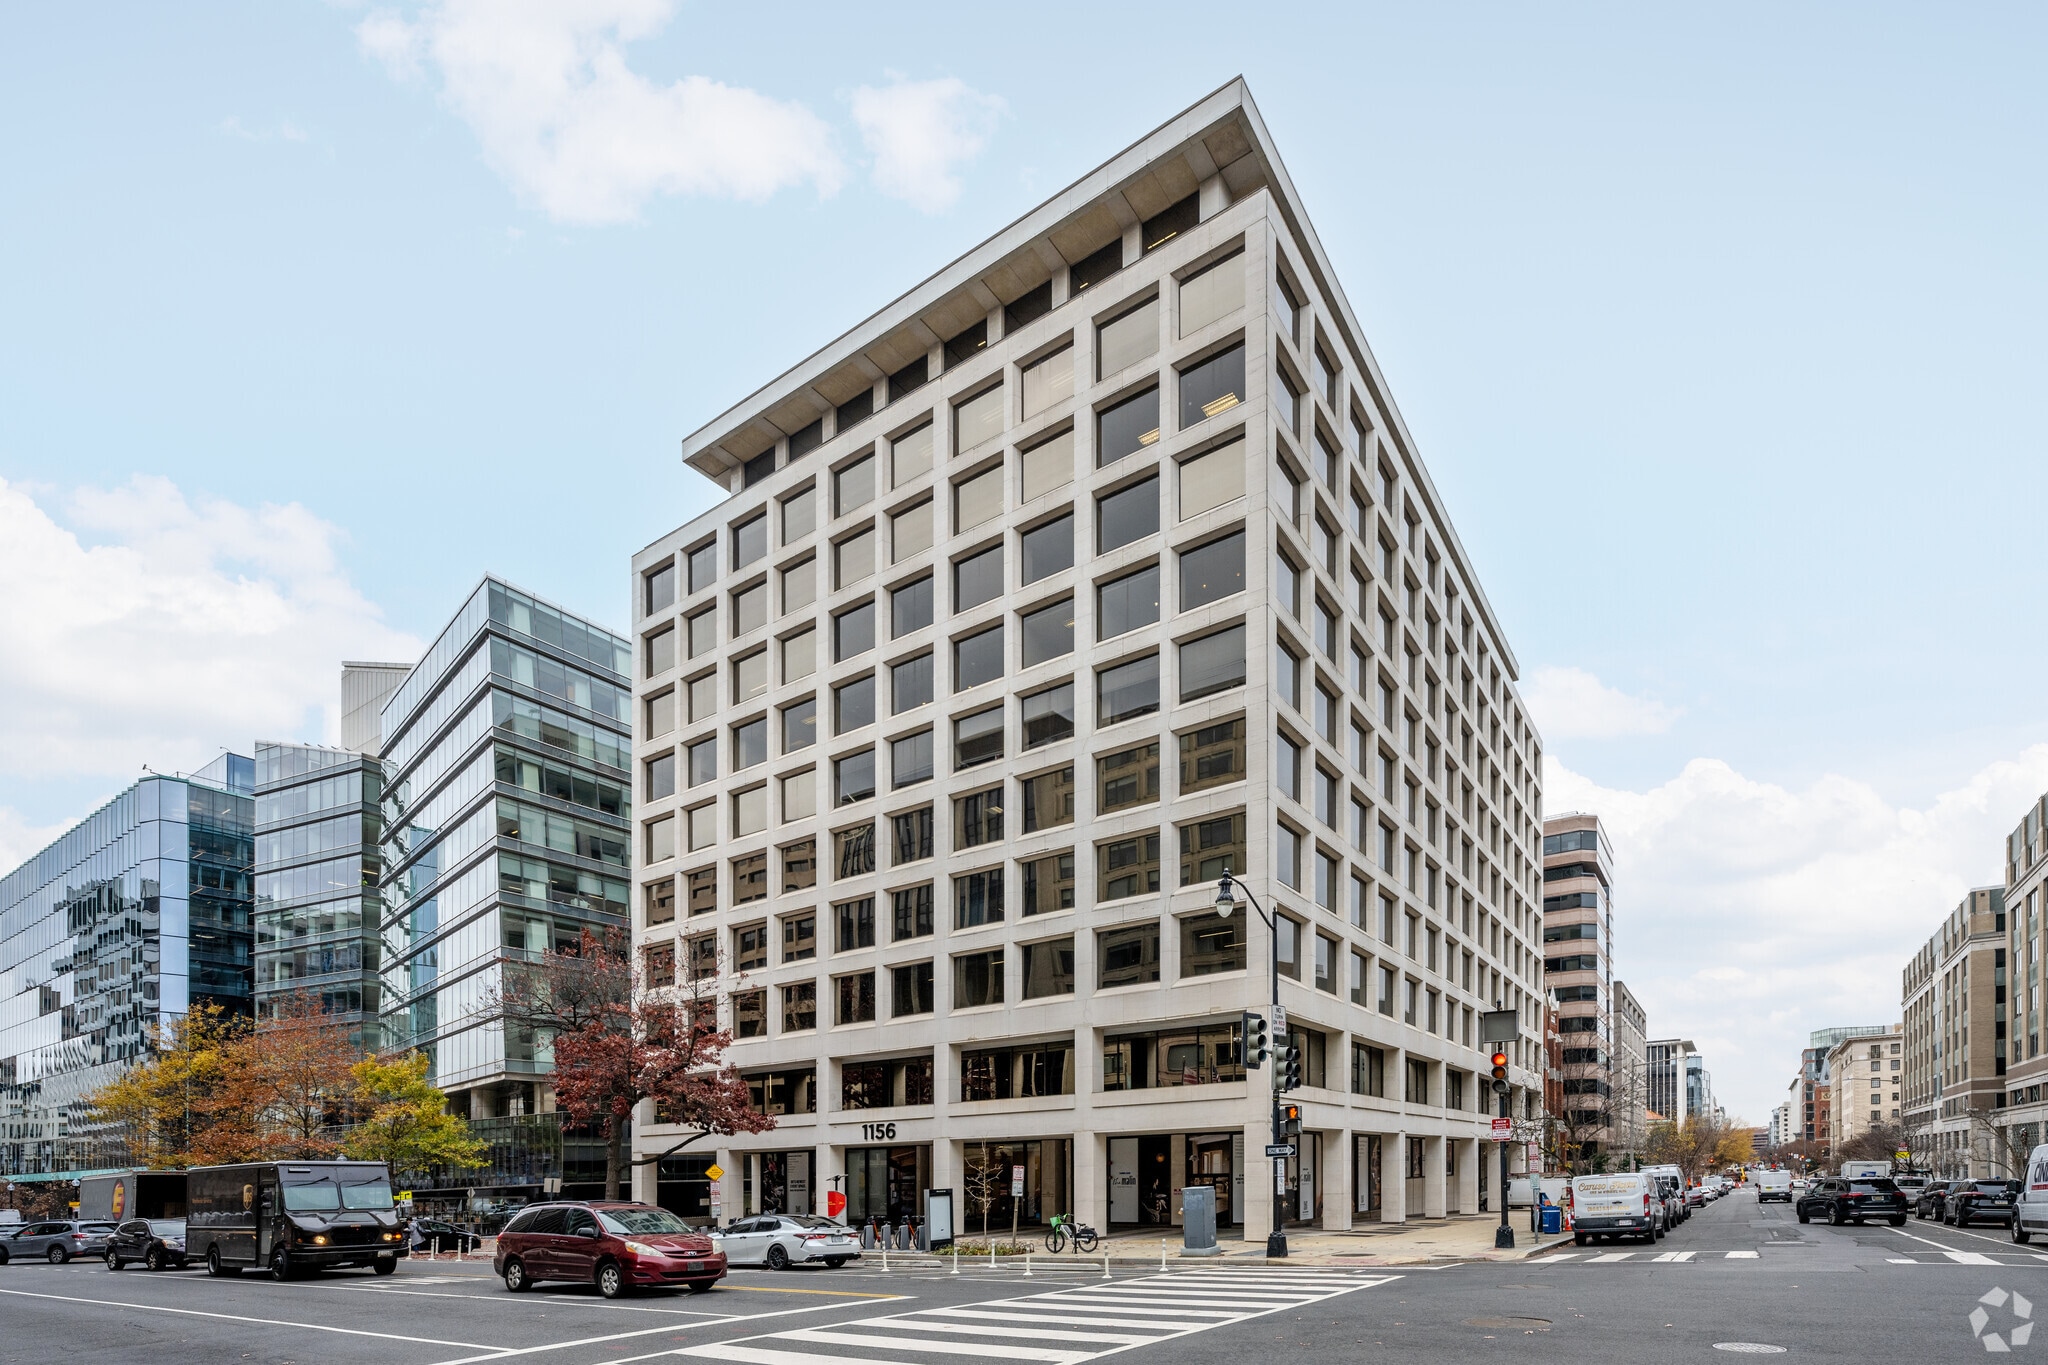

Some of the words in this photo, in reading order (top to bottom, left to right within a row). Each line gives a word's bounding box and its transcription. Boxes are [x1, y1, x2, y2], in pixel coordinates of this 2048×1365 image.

[862, 1123, 896, 1140] 1156
[1578, 1183, 1606, 1192] Caruso
[112, 1187, 125, 1213] E
